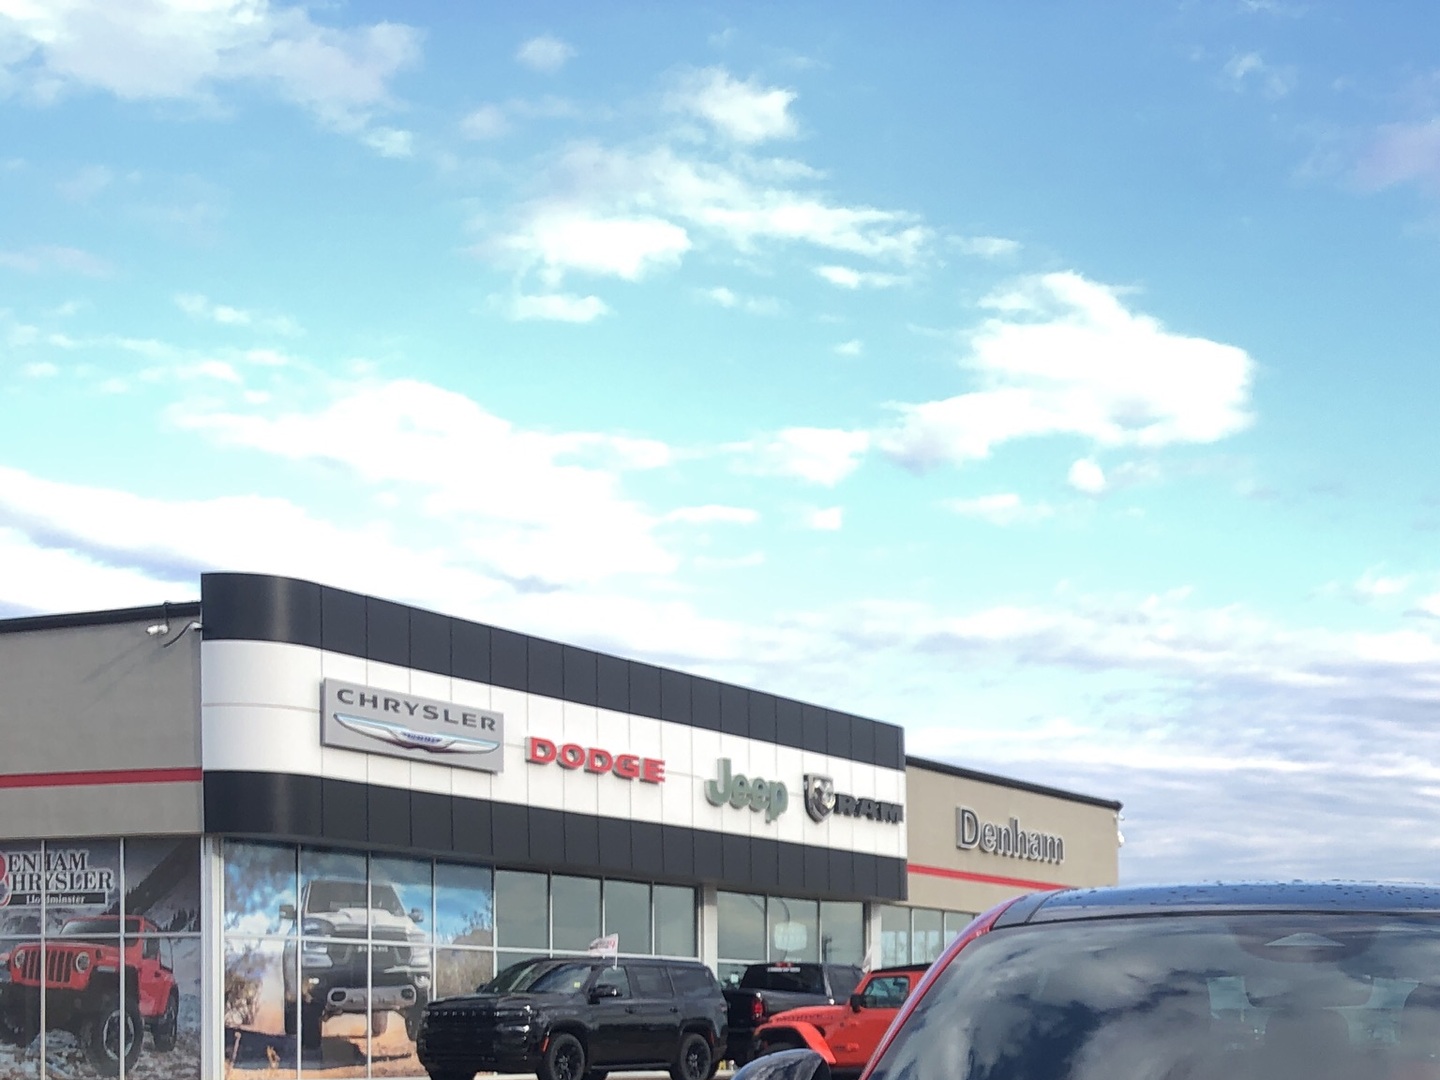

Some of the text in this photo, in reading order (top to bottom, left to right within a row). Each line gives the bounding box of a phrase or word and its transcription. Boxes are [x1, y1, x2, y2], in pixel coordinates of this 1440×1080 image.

[337, 689, 496, 731] CHRYSLER
[525, 736, 665, 784] DODGE
[704, 757, 788, 823] Jeep
[834, 793, 903, 824] RAM
[956, 805, 1064, 865] Denham
[7, 871, 112, 891] HRYSLER
